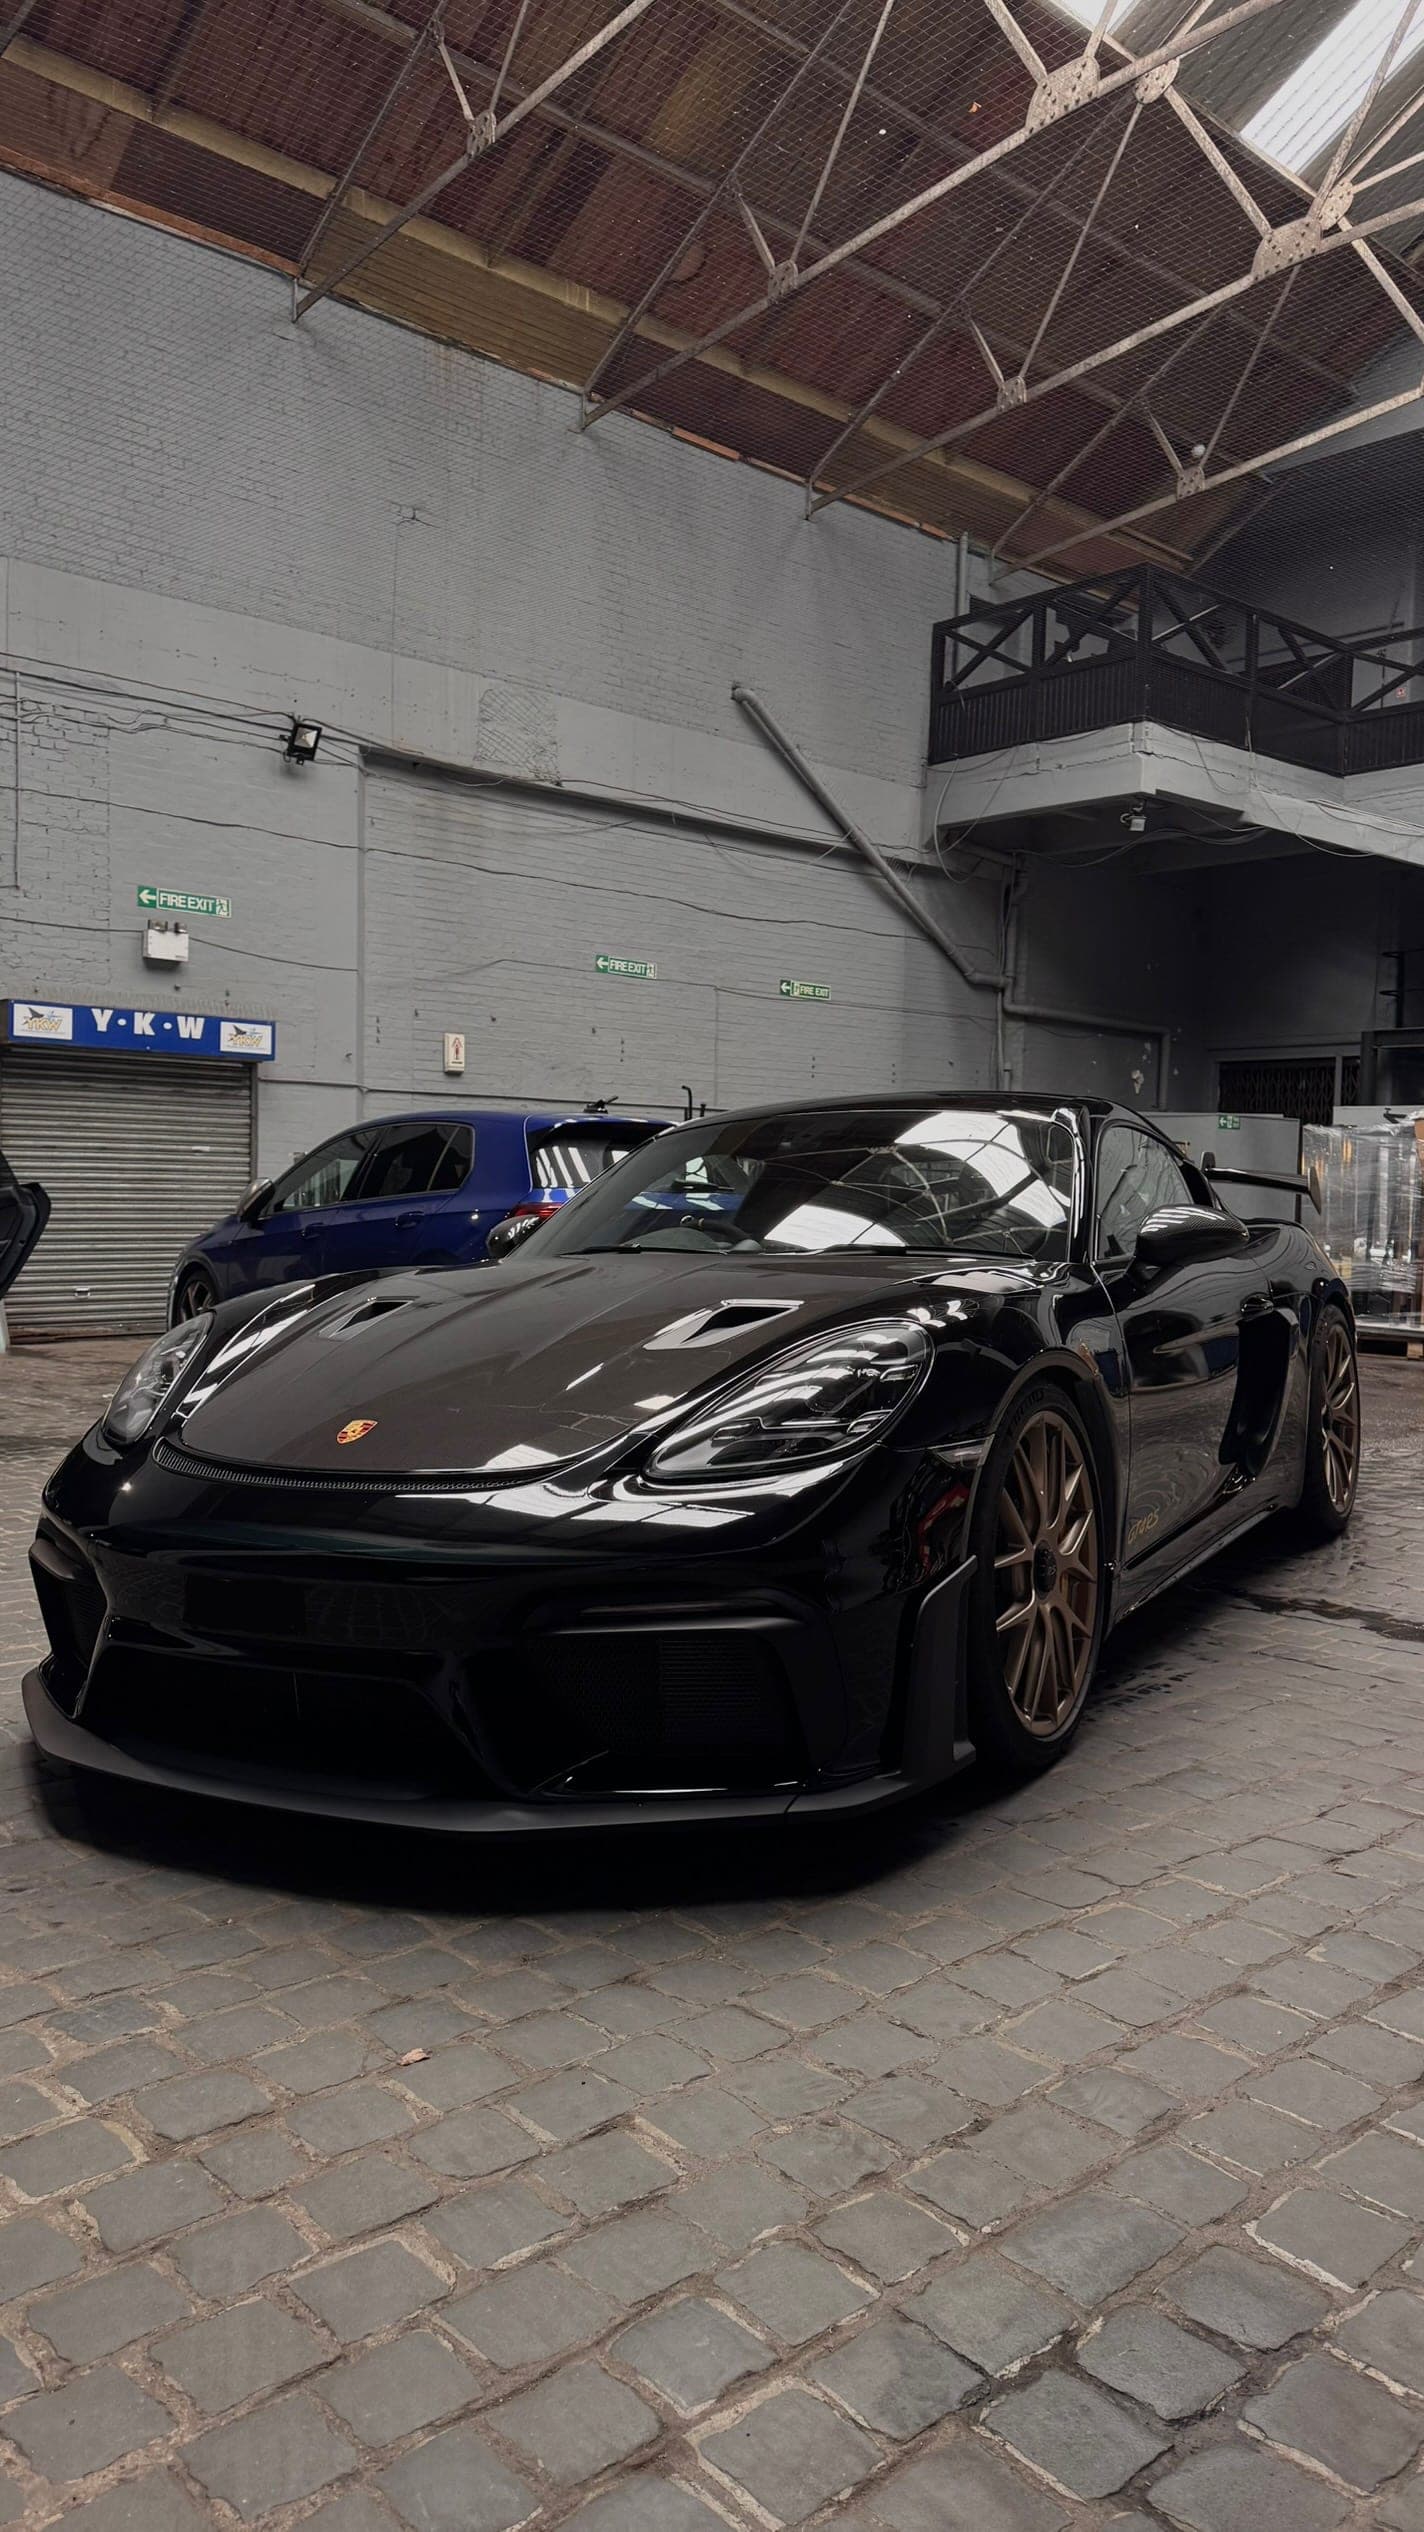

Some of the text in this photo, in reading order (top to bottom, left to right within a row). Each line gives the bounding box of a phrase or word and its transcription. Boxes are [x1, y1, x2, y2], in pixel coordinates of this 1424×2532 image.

[159, 892, 215, 912] FIRE EXIT
[610, 960, 646, 975] FIRE EXIT
[800, 985, 829, 998] FIRE EXIT
